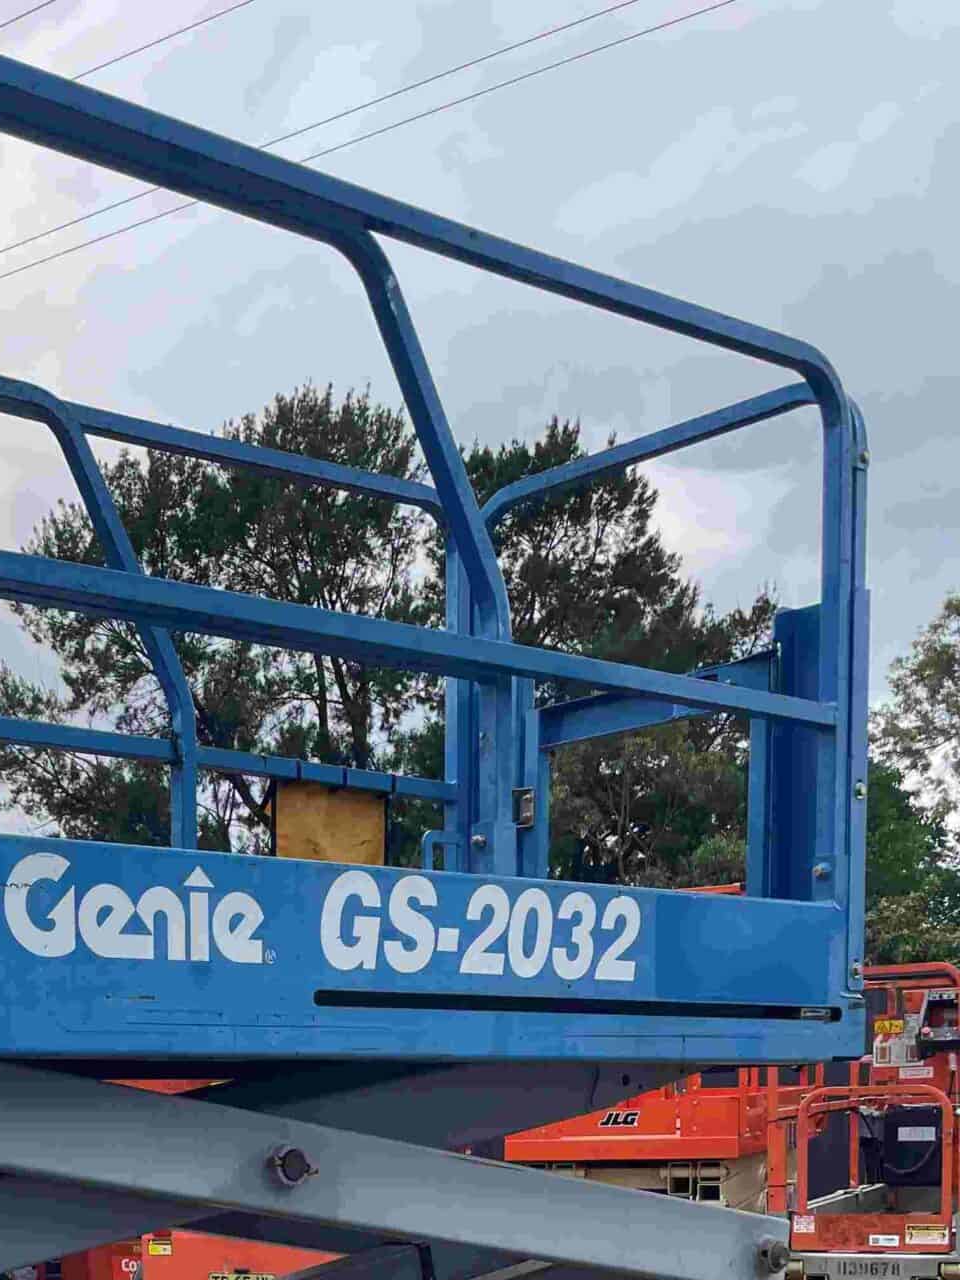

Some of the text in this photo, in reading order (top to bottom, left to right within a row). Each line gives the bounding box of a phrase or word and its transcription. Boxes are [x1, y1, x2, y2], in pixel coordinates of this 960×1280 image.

[4, 855, 263, 964] Genie
[320, 871, 640, 981] GS-2032
[599, 1112, 639, 1126] JLG
